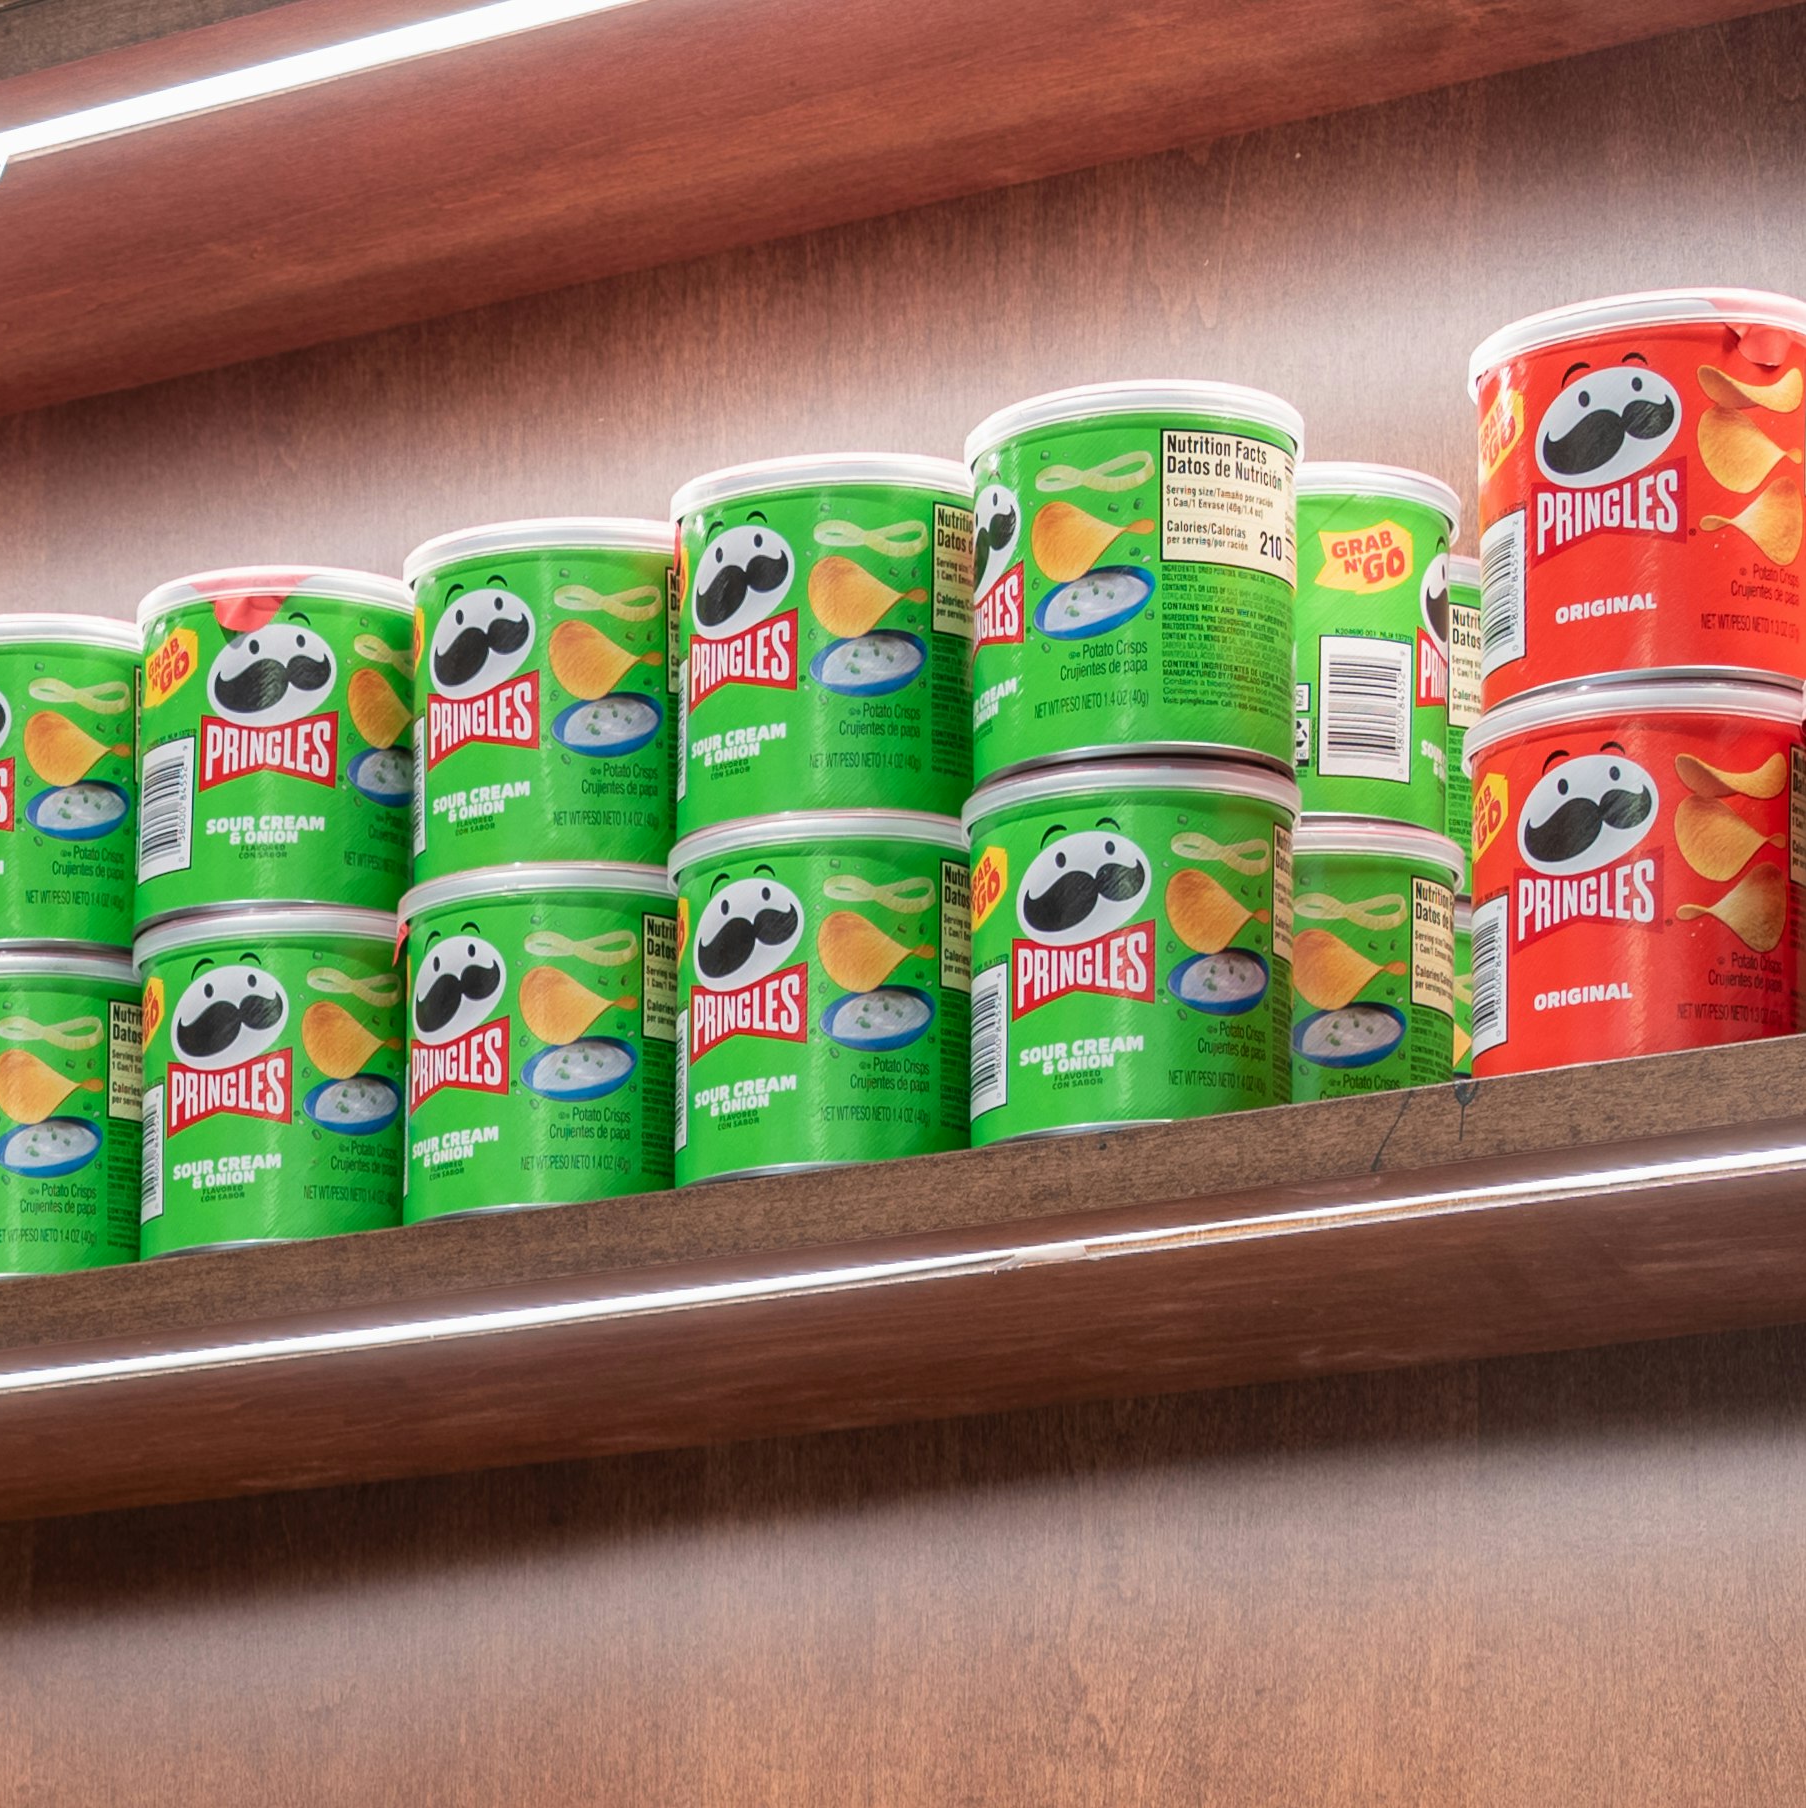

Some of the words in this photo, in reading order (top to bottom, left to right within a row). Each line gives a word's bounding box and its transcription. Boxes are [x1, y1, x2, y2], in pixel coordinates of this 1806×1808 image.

[1167, 434, 1230, 457] Nutrition
[1236, 441, 1267, 465] Facts
[1167, 456, 1210, 475] Datos
[1215, 459, 1230, 478] de
[1235, 462, 1282, 491] Nutrición
[1536, 468, 1678, 556] PRINGLES
[1260, 531, 1282, 561] 210
[1332, 530, 1394, 559] GRAB
[1555, 593, 1657, 625] ORIGINAL
[691, 620, 789, 699] PRINGLES
[1082, 643, 1114, 659] Potato
[1123, 660, 1148, 676] papa
[430, 681, 531, 757] PRINGLES
[205, 721, 330, 781] PRINGLES
[206, 817, 254, 835] SOUR
[259, 815, 325, 831] CREAM
[230, 833, 240, 845] &
[245, 831, 298, 844] ONION
[1517, 858, 1655, 942] PRINGLES
[1017, 931, 1147, 1009] PRINGLES
[1533, 982, 1633, 1011] ORIGINAL
[693, 974, 800, 1053] PRINGLES
[1020, 1043, 1067, 1067] SOUR
[1072, 1035, 1144, 1056] CREAM
[1042, 1061, 1053, 1076] &
[1057, 1053, 1115, 1072] ONION
[411, 1032, 502, 1105] PRINGLES
[172, 1058, 285, 1126] PRINGLES
[695, 1086, 730, 1110] SOUR
[733, 1075, 797, 1097] CREAM
[710, 1103, 720, 1118] &
[721, 1094, 769, 1114] ONION
